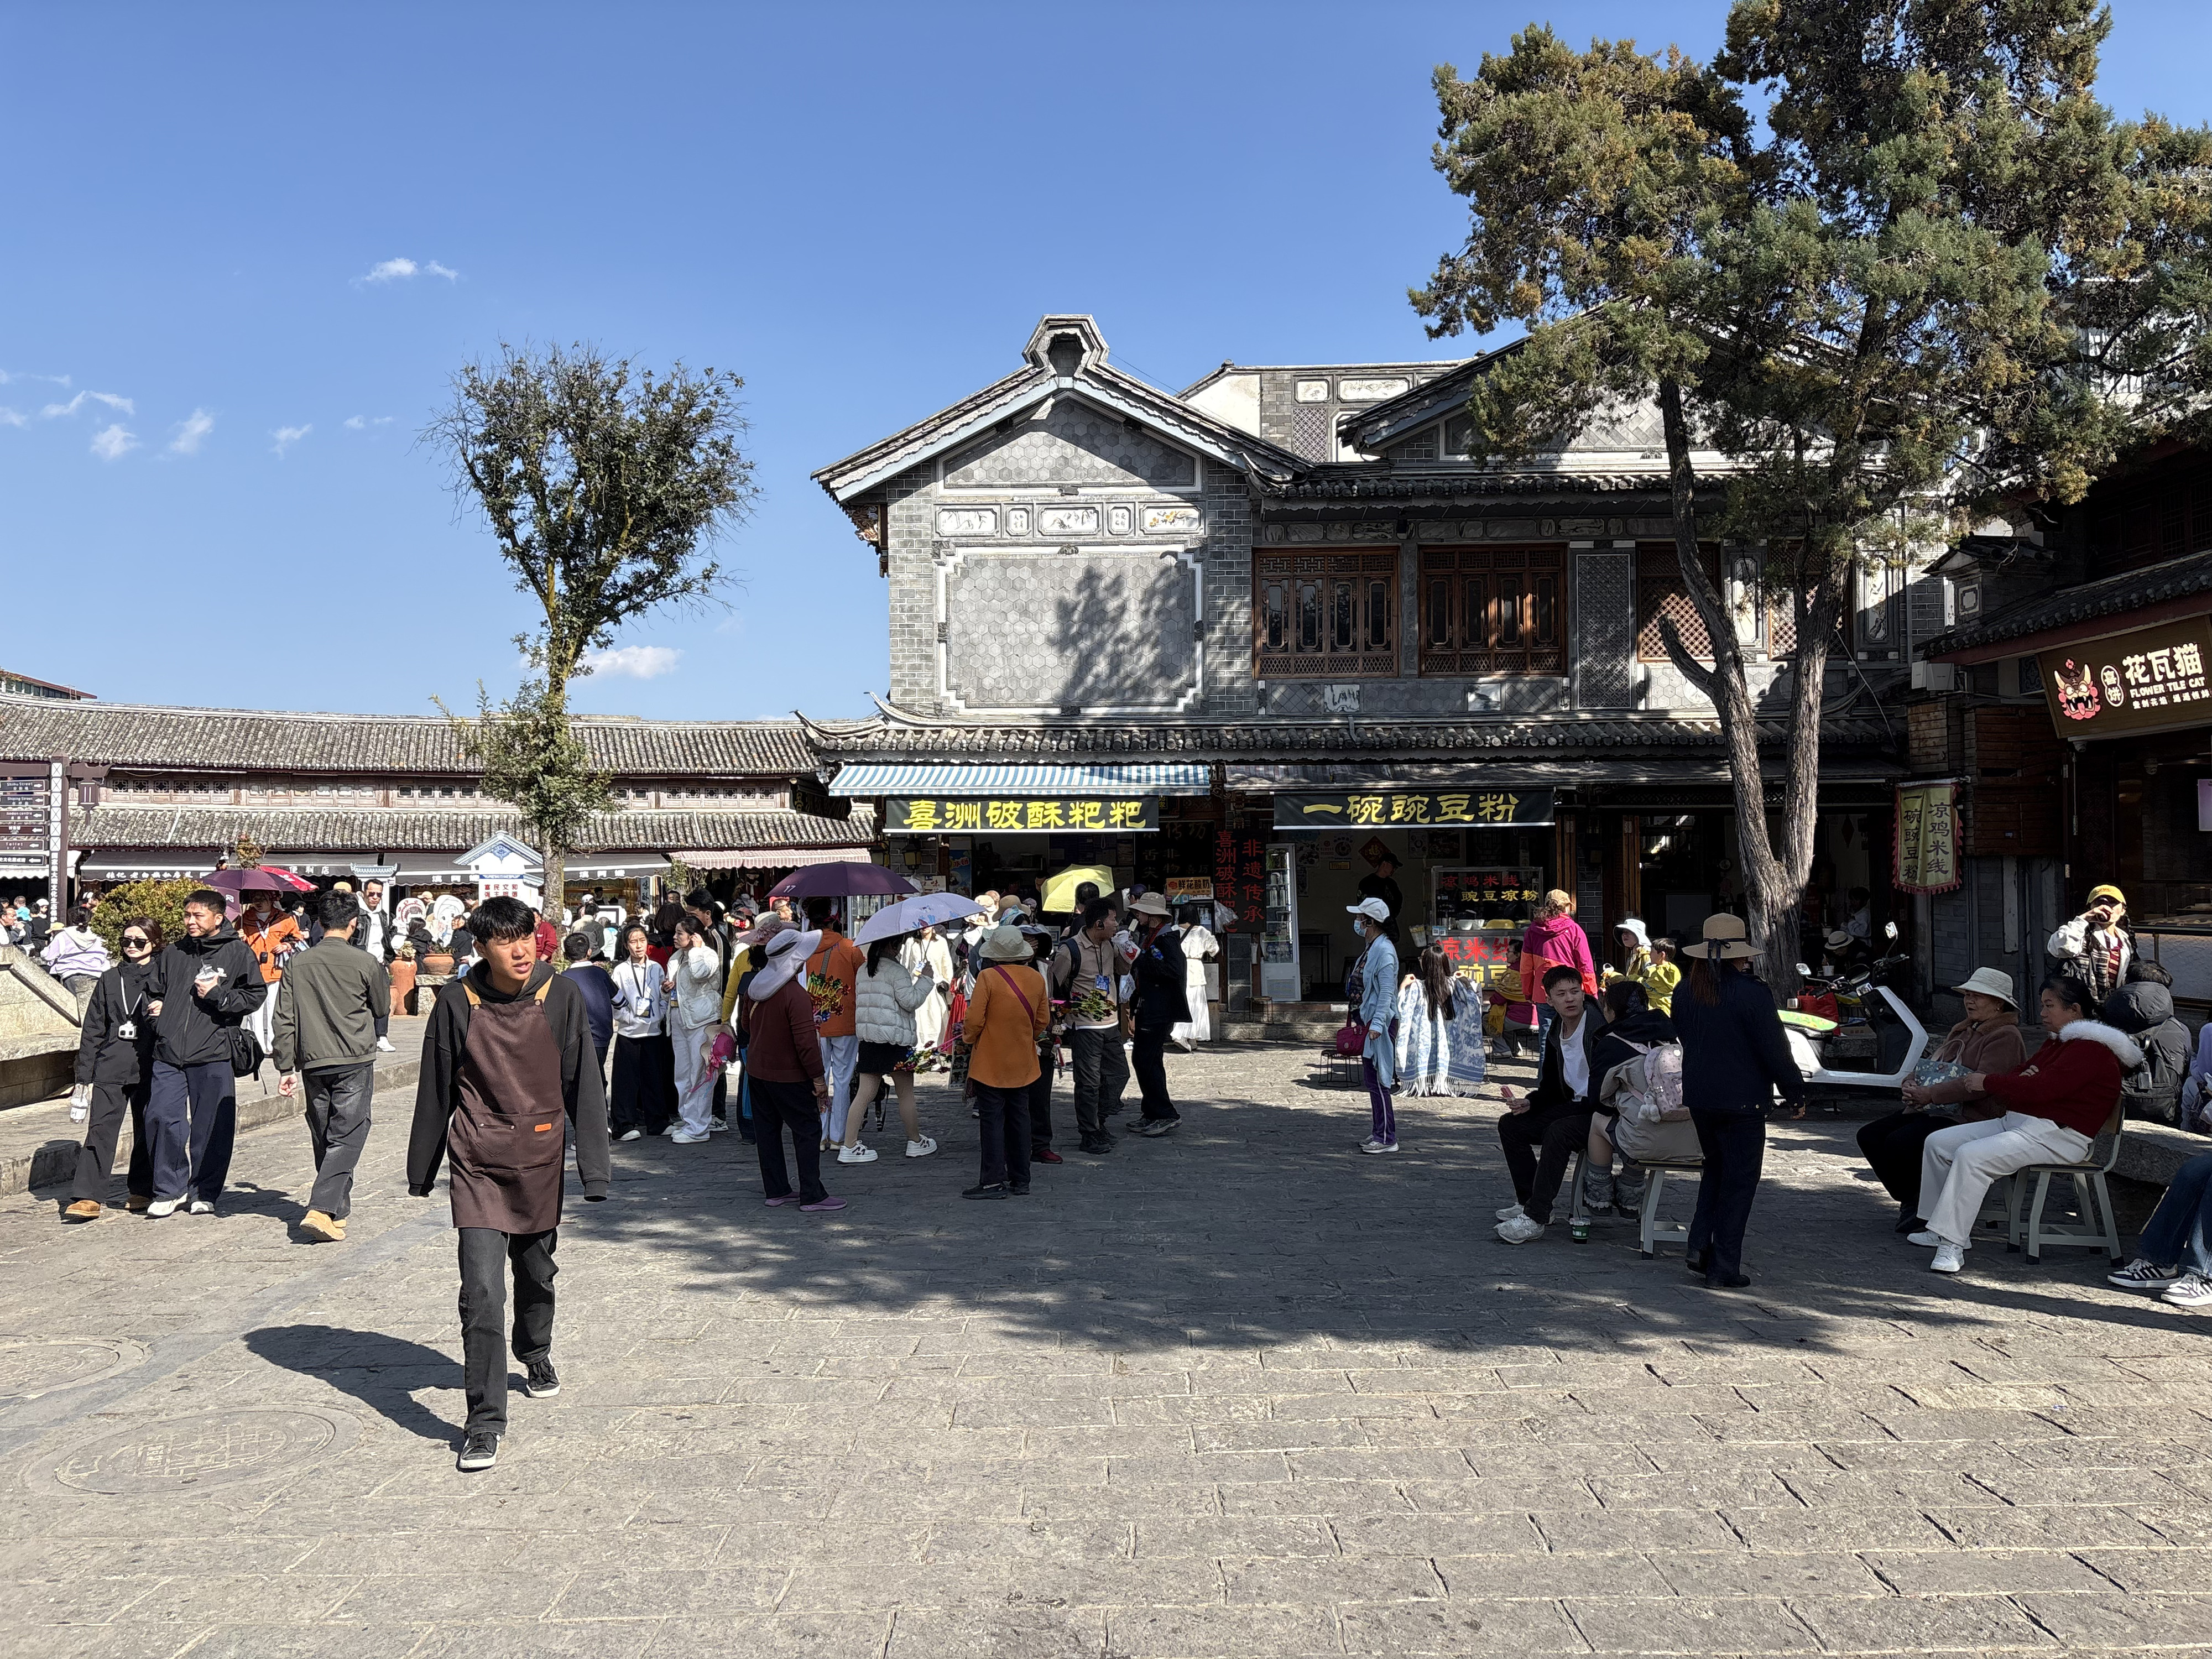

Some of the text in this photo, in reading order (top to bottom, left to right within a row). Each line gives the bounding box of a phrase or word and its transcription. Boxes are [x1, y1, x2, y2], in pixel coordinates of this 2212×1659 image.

[2122, 642, 2203, 686] 花瓦猫
[2103, 670, 2122, 702] 喜饼
[2129, 676, 2205, 698] FLOWER TILE CAT
[904, 800, 1146, 830] 喜洲破酥粑粑
[1303, 793, 1520, 823] 一碗豌豆粉
[1926, 802, 1952, 874] 凉鸡米线
[289, 866, 330, 874] 便利店
[1242, 839, 1265, 923] 非遗传承
[1441, 874, 1520, 887] 凉鸡米线
[783, 885, 796, 893] 17
[1178, 879, 1210, 890] 鲜花酸奶
[1461, 889, 1540, 902] 豌豆凉粉
